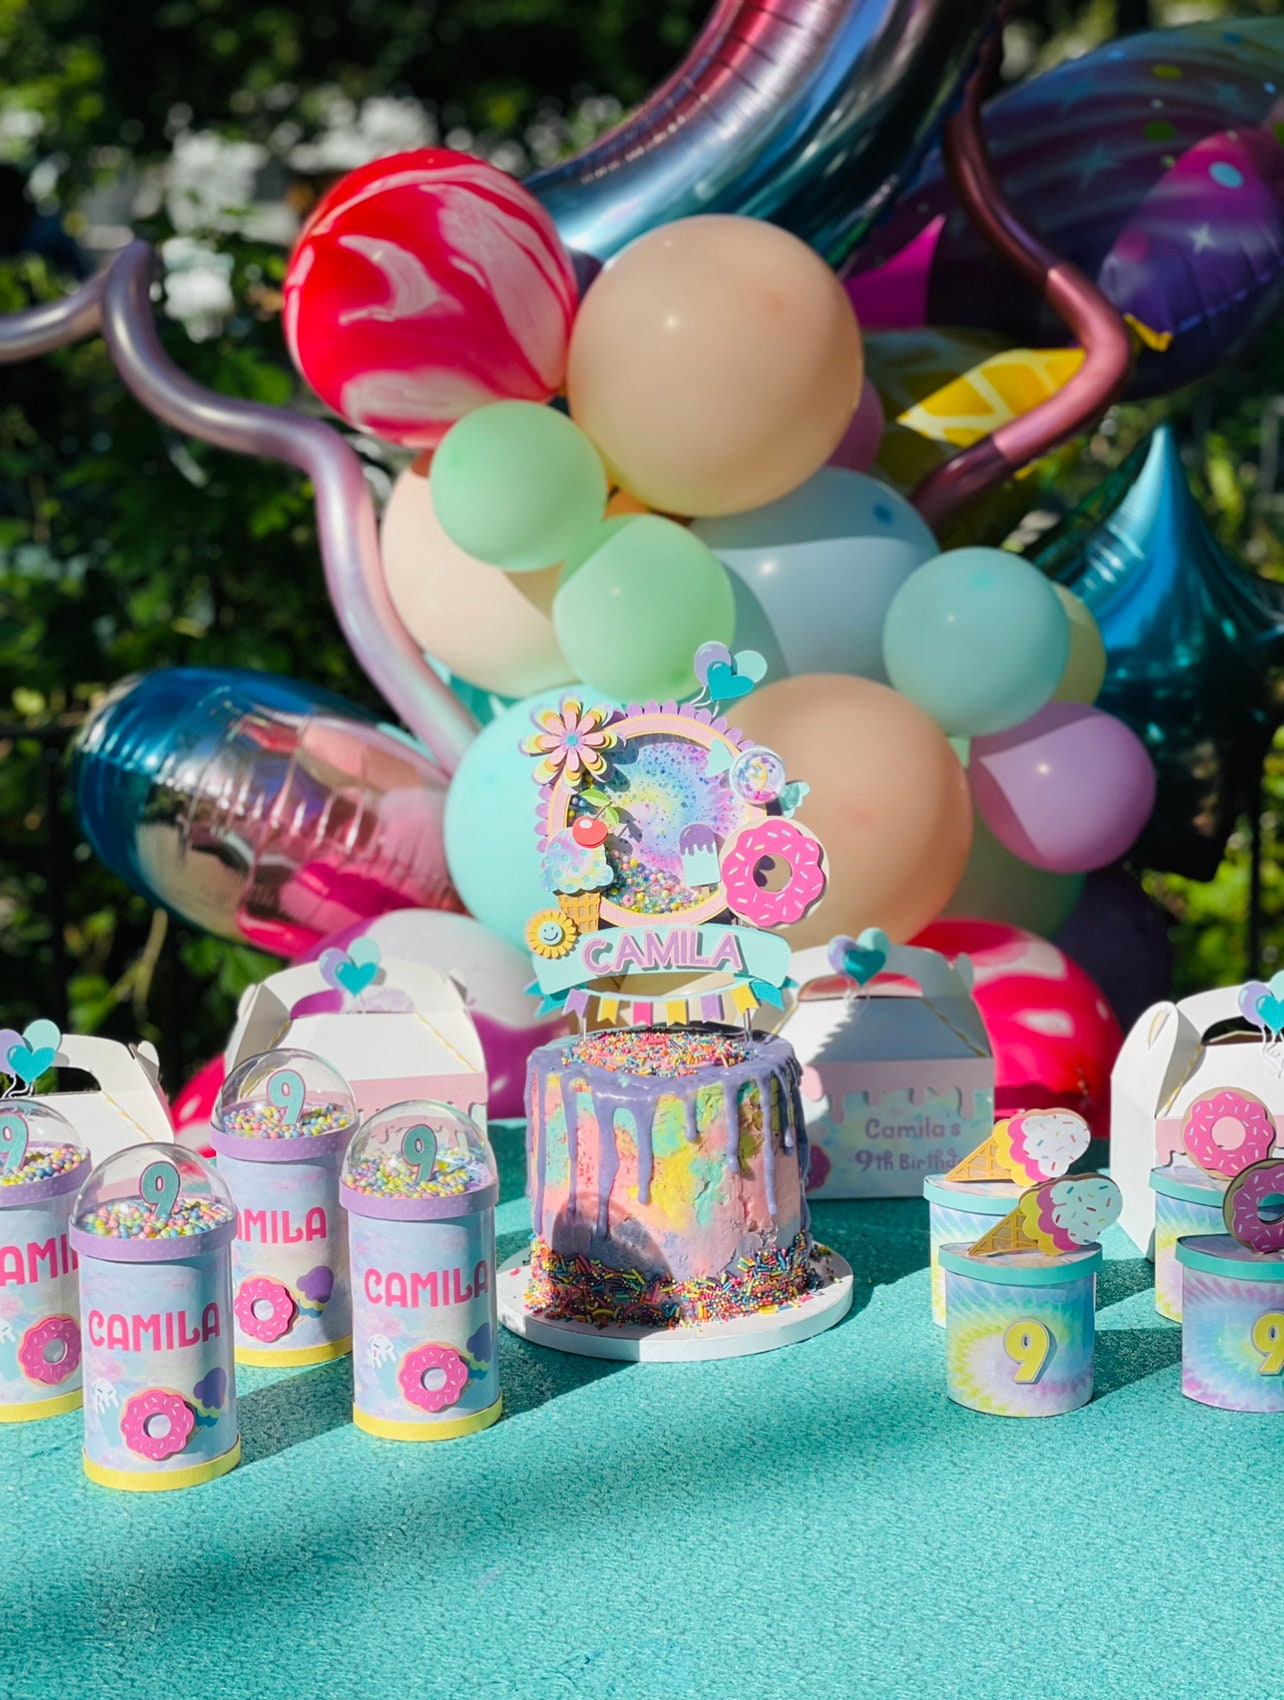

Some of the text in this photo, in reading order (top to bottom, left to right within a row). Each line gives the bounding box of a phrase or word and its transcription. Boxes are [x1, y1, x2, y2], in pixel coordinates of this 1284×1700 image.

[582, 928, 743, 975] CAMILA
[267, 1069, 306, 1126] 9
[0, 1111, 29, 1170] 9
[401, 1123, 438, 1182] 9
[855, 1149, 894, 1173] 9th
[139, 1161, 180, 1217] 9
[364, 1259, 489, 1308] CAMILA
[88, 1302, 221, 1351] CAMILA
[1003, 1318, 1050, 1383] 9
[1250, 1310, 1284, 1375] 9
